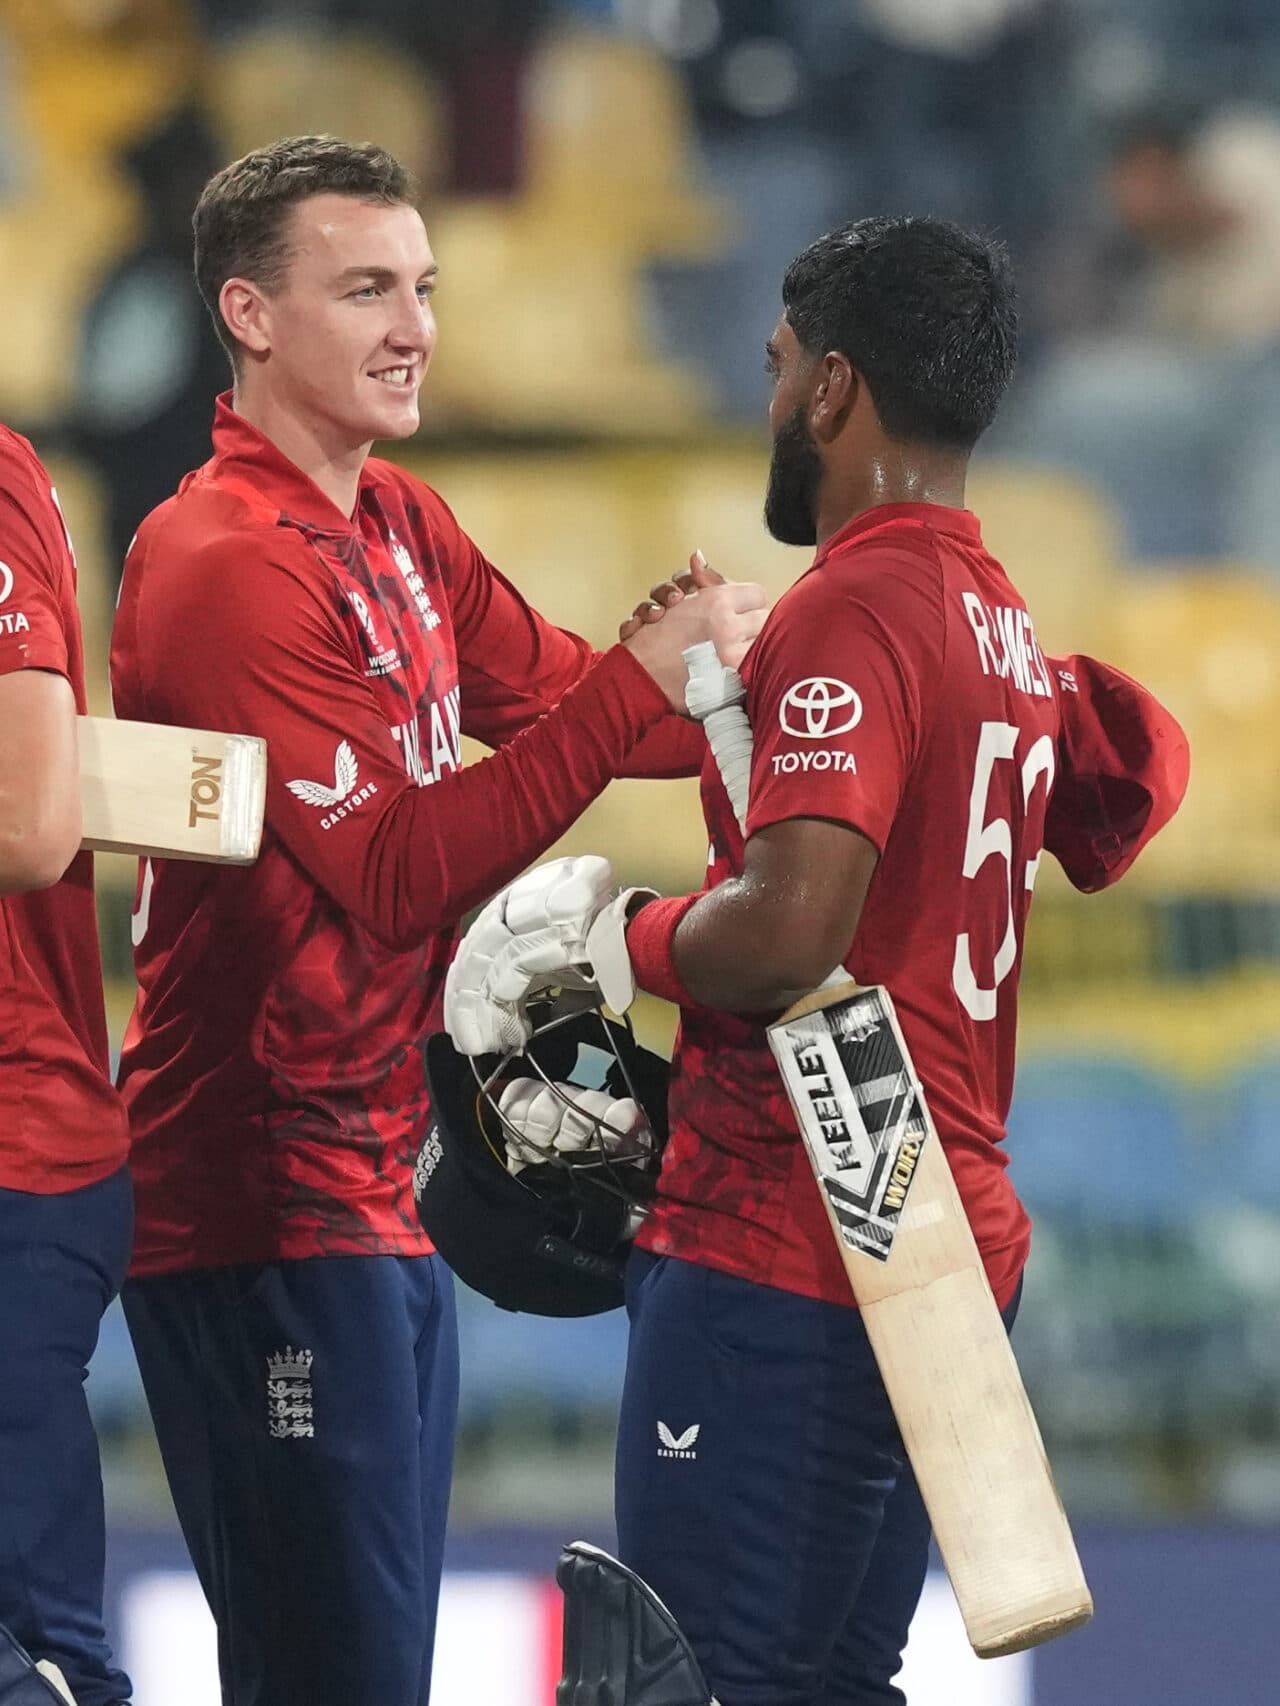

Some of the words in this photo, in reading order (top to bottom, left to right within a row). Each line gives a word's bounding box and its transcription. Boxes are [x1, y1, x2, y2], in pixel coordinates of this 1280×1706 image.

[1058, 670, 1079, 693] 92
[772, 750, 857, 776] TOYOTA
[188, 756, 223, 828] TON
[320, 782, 378, 830] CASTORE
